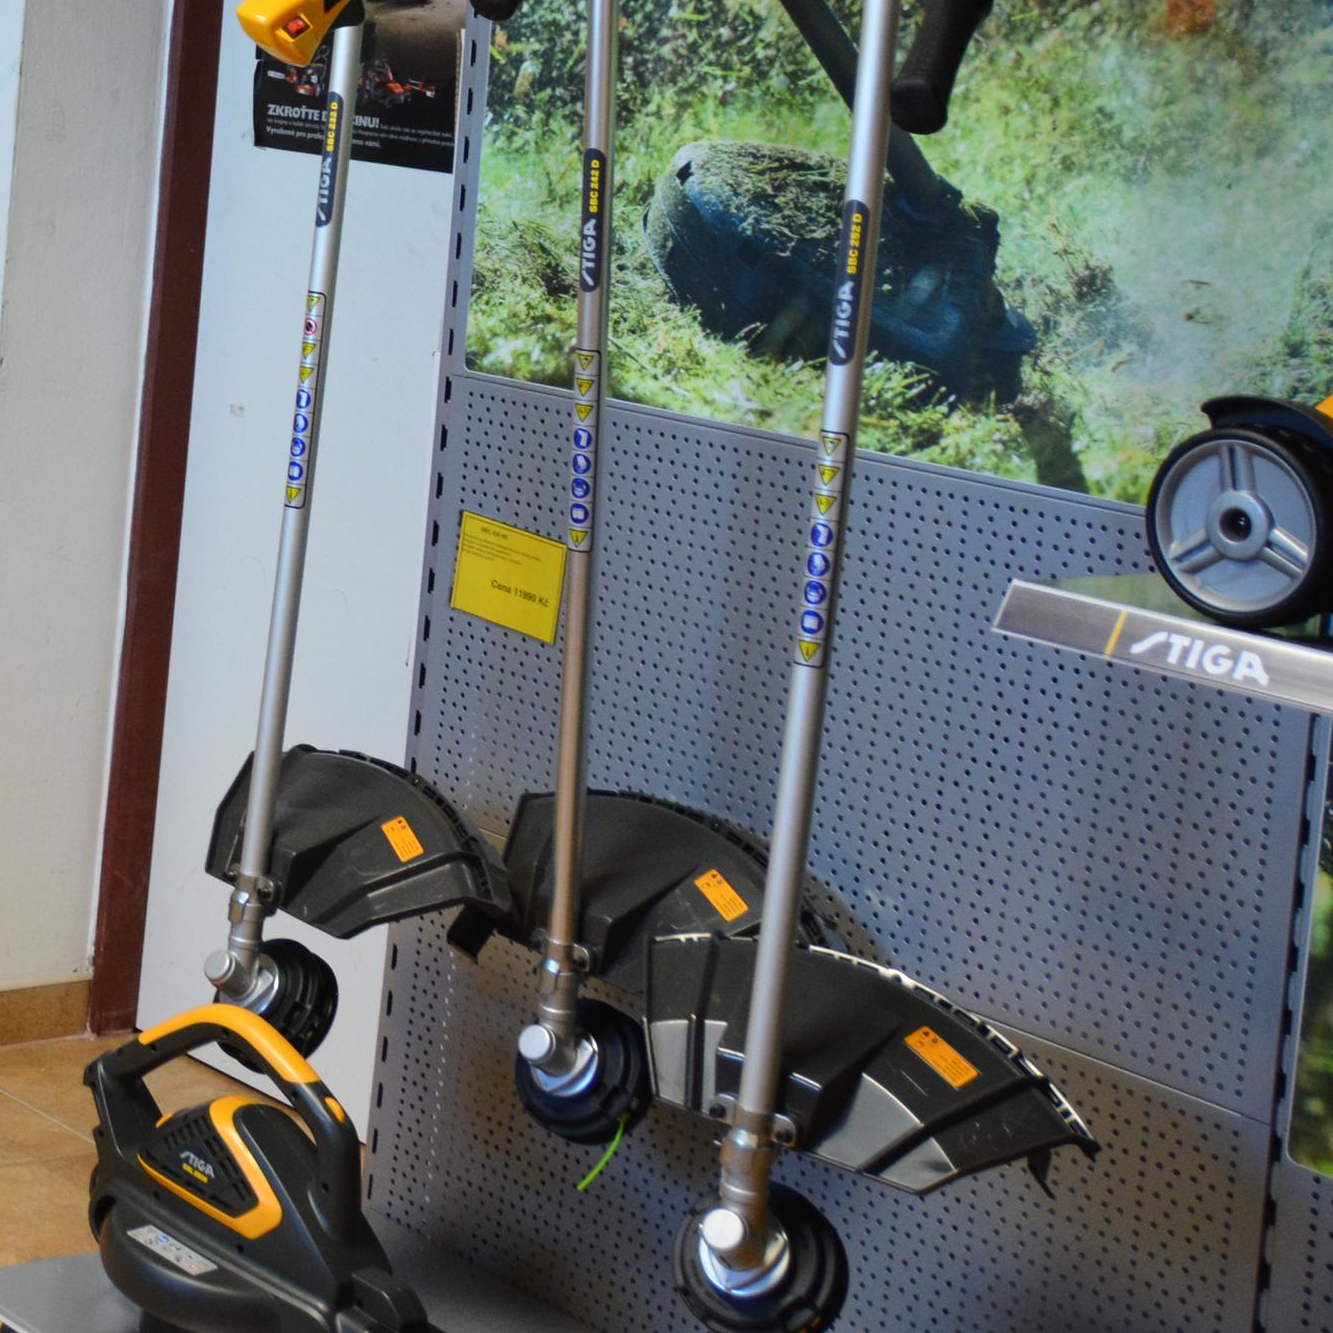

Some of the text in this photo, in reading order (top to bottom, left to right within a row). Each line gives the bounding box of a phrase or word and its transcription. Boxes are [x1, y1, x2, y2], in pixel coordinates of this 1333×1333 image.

[268, 104, 320, 121] ZKROŤTE
[318, 157, 332, 221] STIGA
[589, 191, 599, 213] SBC
[852, 213, 863, 223] D
[582, 218, 597, 286] STIGA
[847, 249, 859, 275] SBC
[833, 281, 854, 359] STIGA
[492, 579, 512, 595] Cena
[1130, 631, 1270, 686] STIGA
[179, 1151, 215, 1178] STIGA
